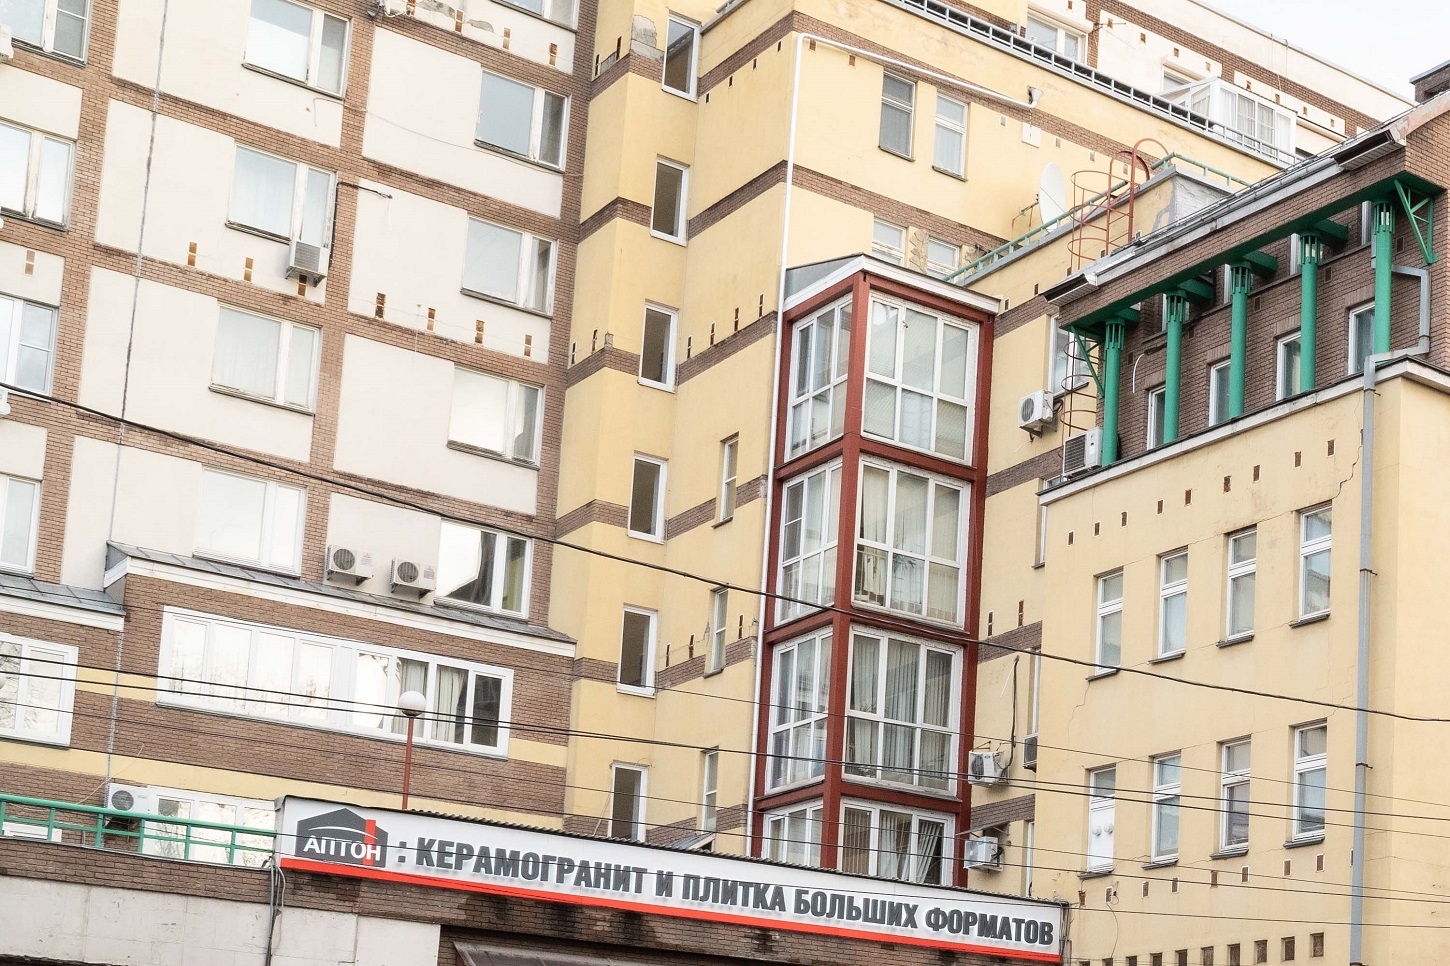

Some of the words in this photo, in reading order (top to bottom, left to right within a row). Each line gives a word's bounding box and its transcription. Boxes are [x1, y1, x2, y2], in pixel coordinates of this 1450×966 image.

[303, 835, 381, 861] АПТОН
[416, 837, 648, 894] КЕРАМОГРАНИТ
[655, 870, 674, 897] И
[682, 874, 786, 912] ПЛИТКА
[795, 889, 918, 928] БОЛЬШИХ
[925, 906, 1053, 945] ФОРМАТОВ
